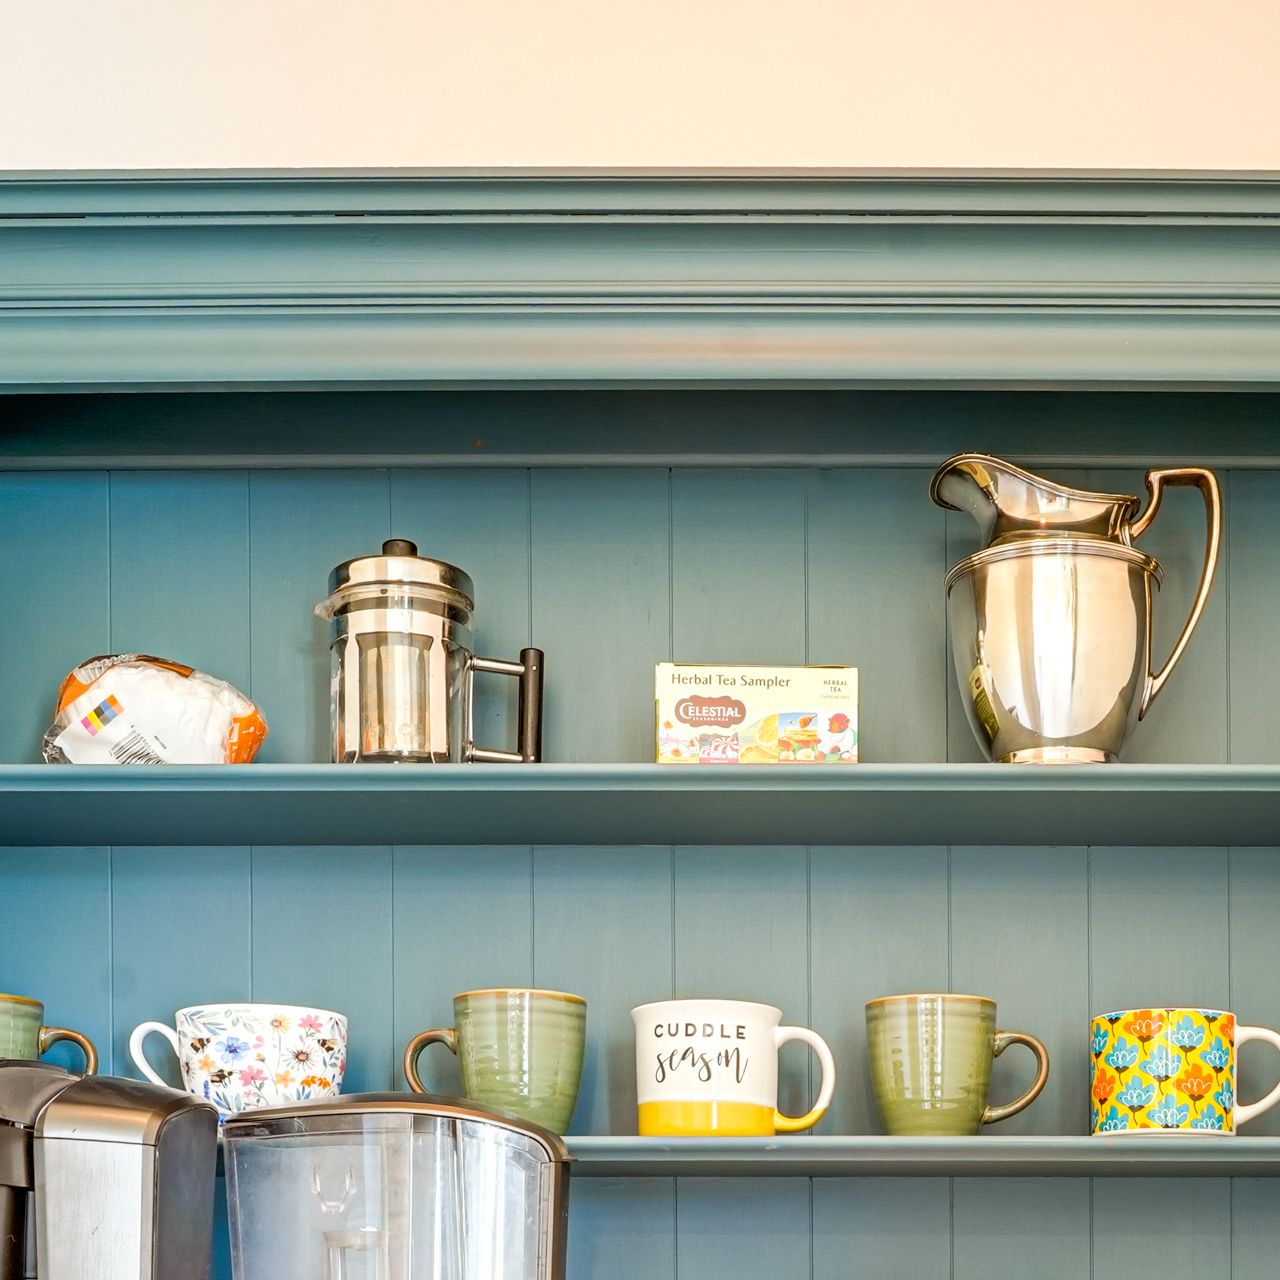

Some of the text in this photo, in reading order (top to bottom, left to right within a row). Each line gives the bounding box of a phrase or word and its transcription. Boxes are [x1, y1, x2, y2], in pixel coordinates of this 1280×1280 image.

[671, 673, 792, 690] Herbal Tea Sampler
[679, 702, 742, 720] CELESTIAL
[654, 1022, 747, 1040] CUDDLE
[654, 1046, 749, 1084] season
